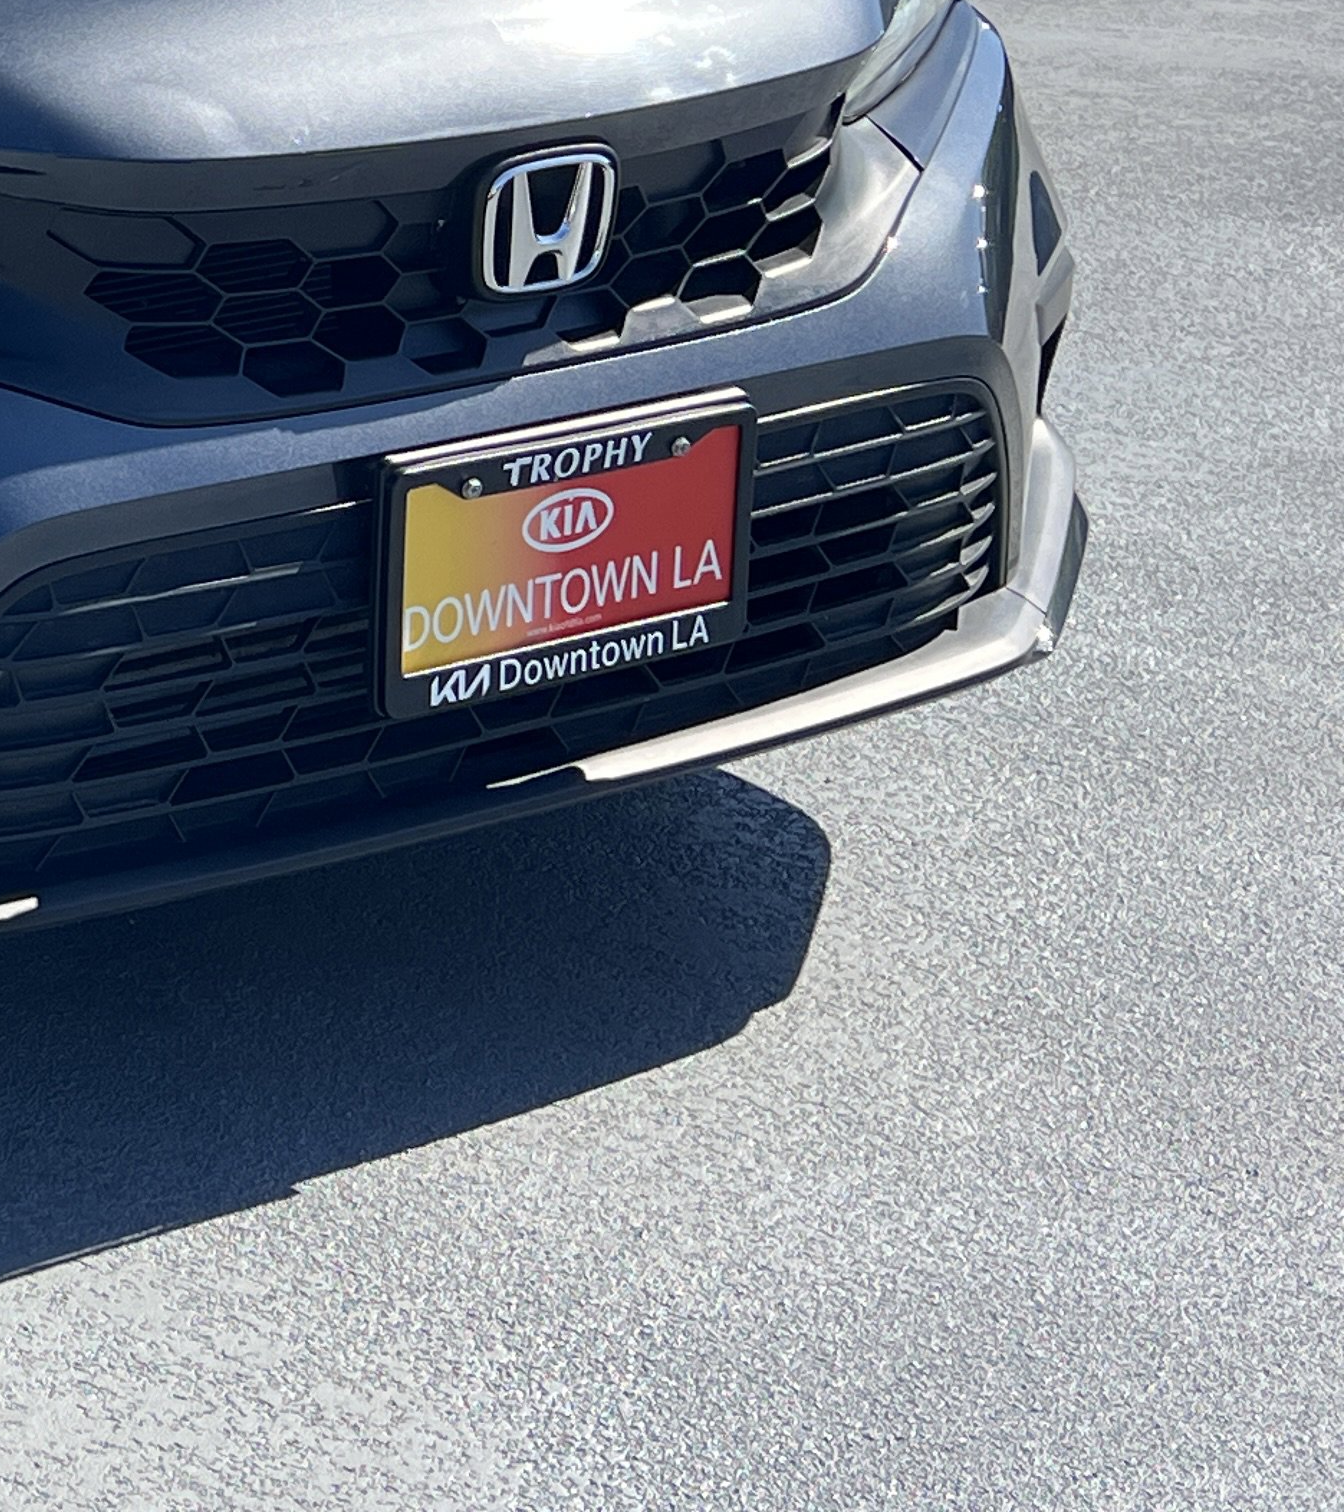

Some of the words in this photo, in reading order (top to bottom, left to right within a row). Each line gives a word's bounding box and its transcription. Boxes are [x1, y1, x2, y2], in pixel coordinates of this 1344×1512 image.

[503, 432, 653, 487] TROPHY
[539, 496, 598, 542] KIA
[403, 550, 659, 653] DOWNTOWN
[672, 539, 723, 590] LA
[430, 663, 491, 708] KIA
[499, 629, 664, 692] Downtown
[671, 613, 710, 651] LA
